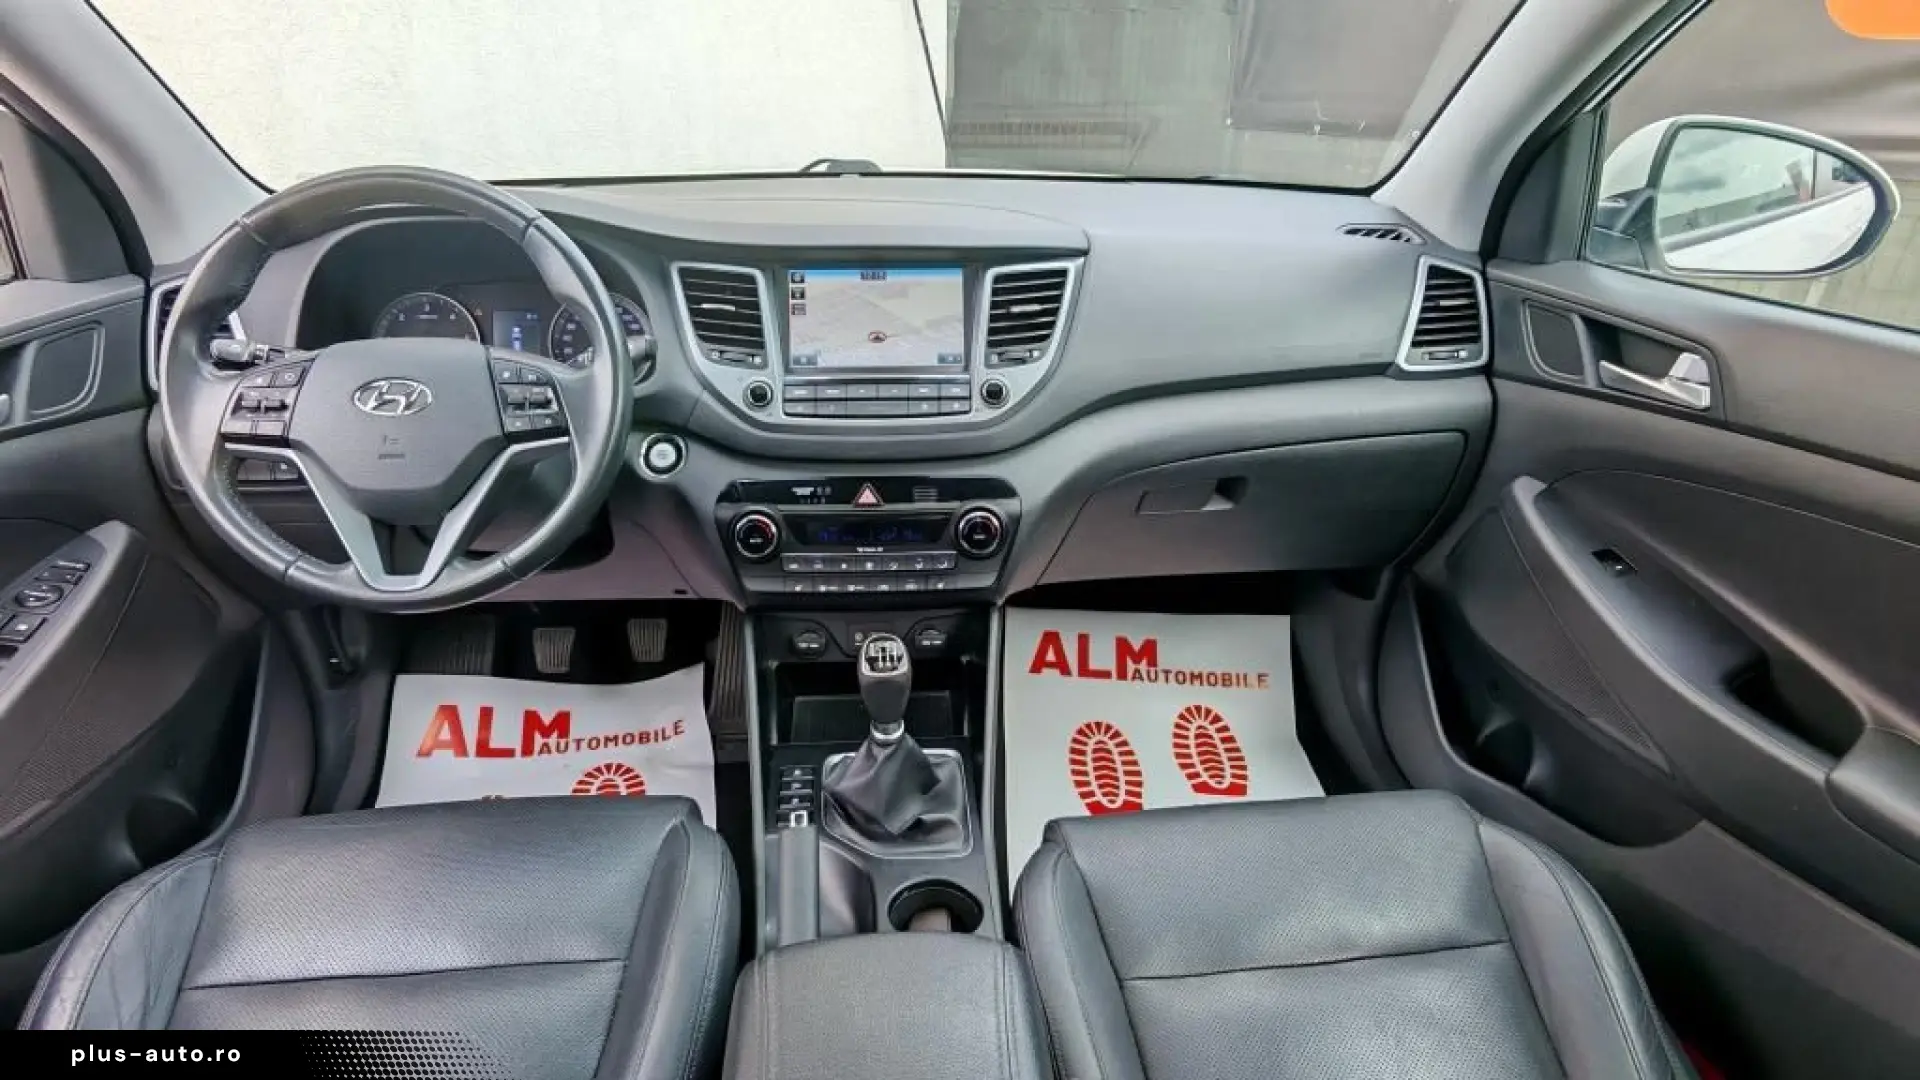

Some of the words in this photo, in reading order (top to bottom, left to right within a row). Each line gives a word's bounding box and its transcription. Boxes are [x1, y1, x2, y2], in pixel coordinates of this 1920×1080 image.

[1028, 629, 1158, 681] ALM
[1131, 667, 1270, 689] AUTOMOBILE
[416, 704, 571, 758] ALM
[537, 719, 685, 757] AUTOMOBILE
